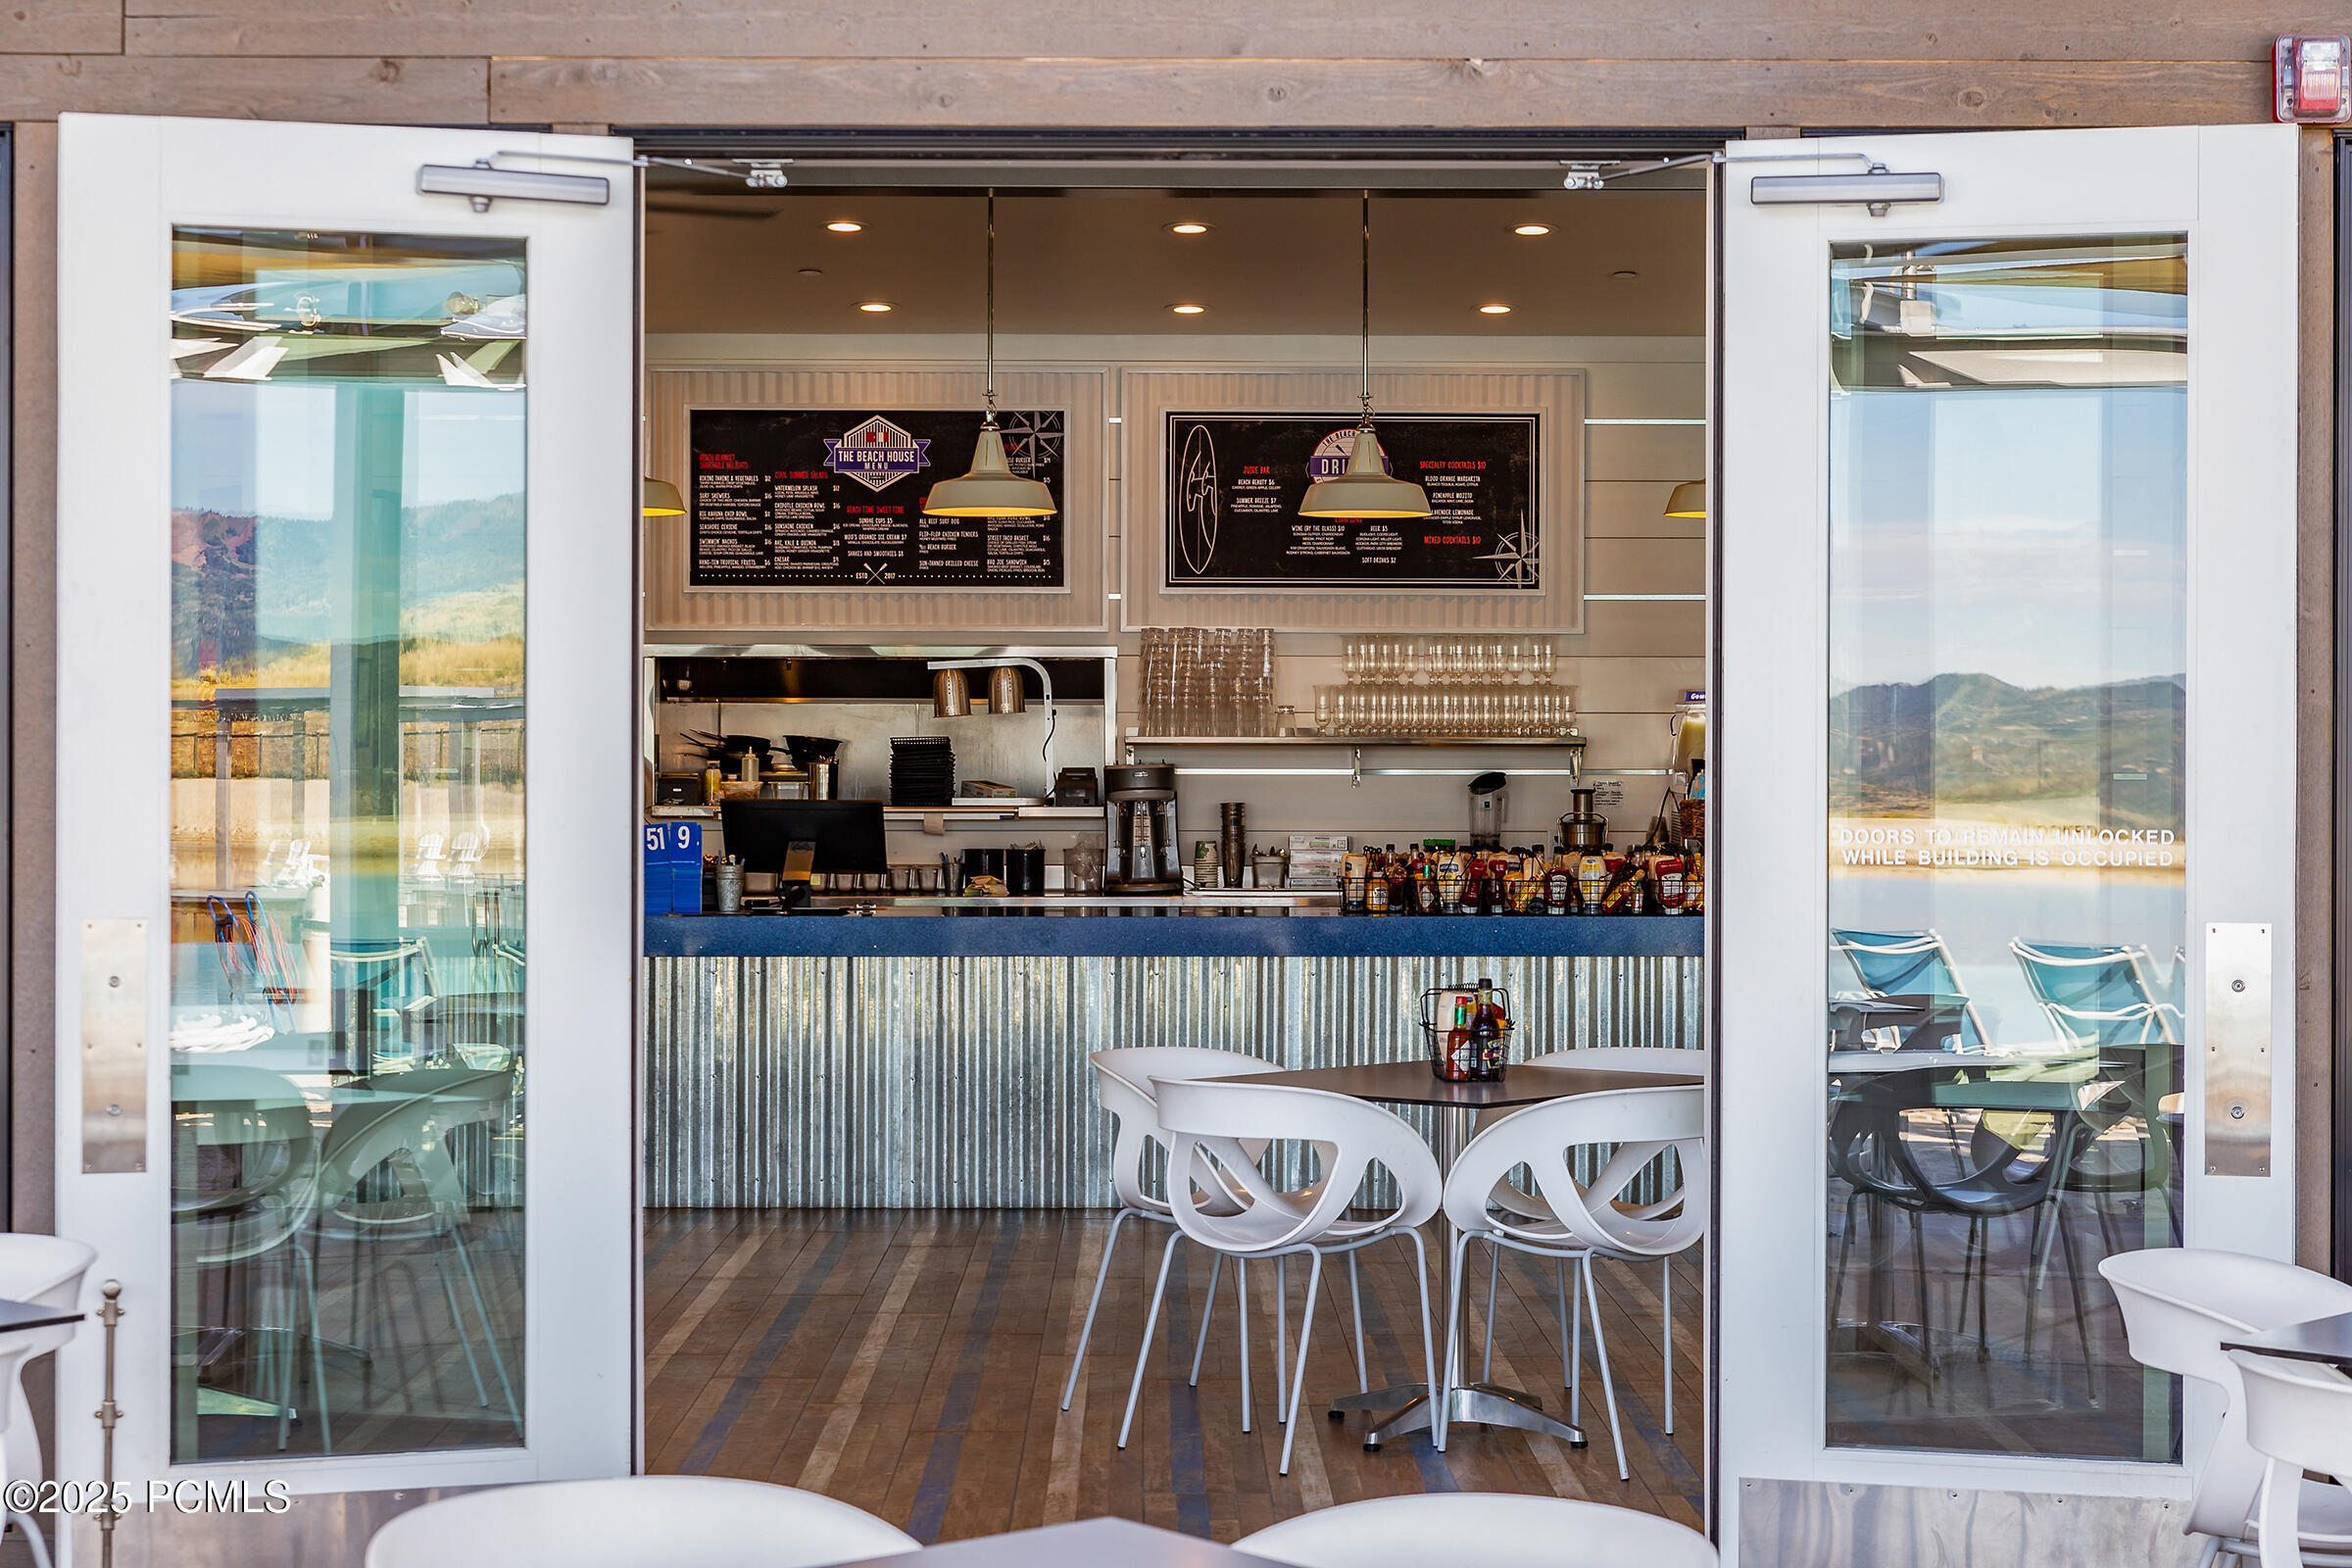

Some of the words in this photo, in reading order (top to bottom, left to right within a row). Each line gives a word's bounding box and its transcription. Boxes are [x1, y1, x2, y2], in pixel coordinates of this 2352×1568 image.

[1323, 436, 1333, 447] THE
[839, 451, 855, 463] THE
[857, 451, 884, 463] BEACH
[887, 451, 915, 463] HOUSE
[864, 462, 888, 470] MENU
[1321, 459, 1345, 474] DRI
[1424, 535, 1441, 544] MIXED
[1443, 535, 1470, 544] COCKTAILS
[647, 827, 664, 851] 51
[678, 825, 690, 849] 9
[1840, 829, 1915, 845] DOORS
[1926, 829, 1950, 845] TO
[1963, 829, 2043, 845] REMAIN
[2058, 829, 2176, 845] UNLOCKED
[1842, 851, 1907, 864] WHILE
[1919, 851, 2018, 865] BUILDING
[2030, 851, 2050, 865] IS
[2061, 851, 2174, 866] OCCUPIED
